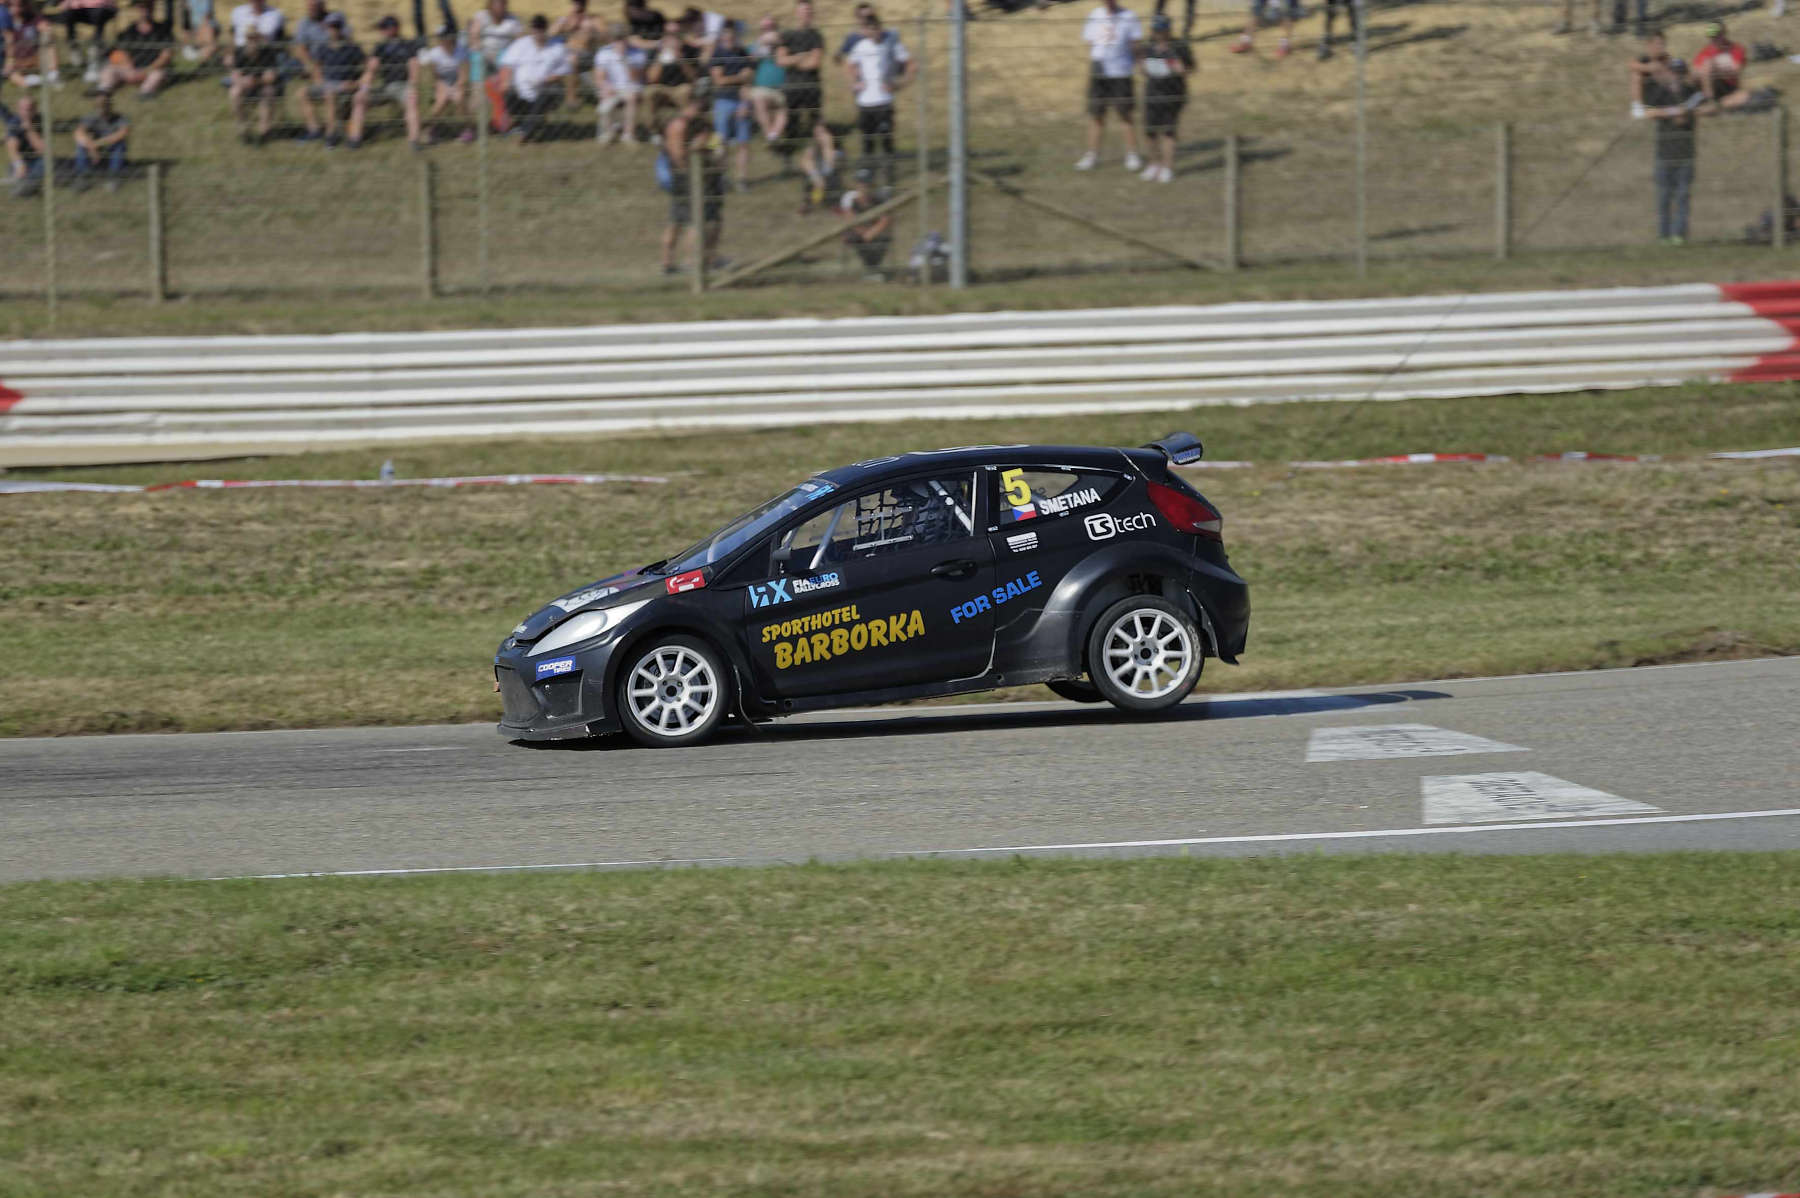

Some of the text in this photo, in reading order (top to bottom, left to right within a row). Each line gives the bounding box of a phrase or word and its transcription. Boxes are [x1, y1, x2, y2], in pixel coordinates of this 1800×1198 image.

[1002, 468, 1031, 506] 5
[1040, 488, 1101, 515] SMETANA
[950, 570, 1042, 624] FOR SALE
[762, 604, 860, 643] SPORTHOTEL
[774, 609, 925, 669] BARBORKA
[538, 660, 573, 673] COOPER
